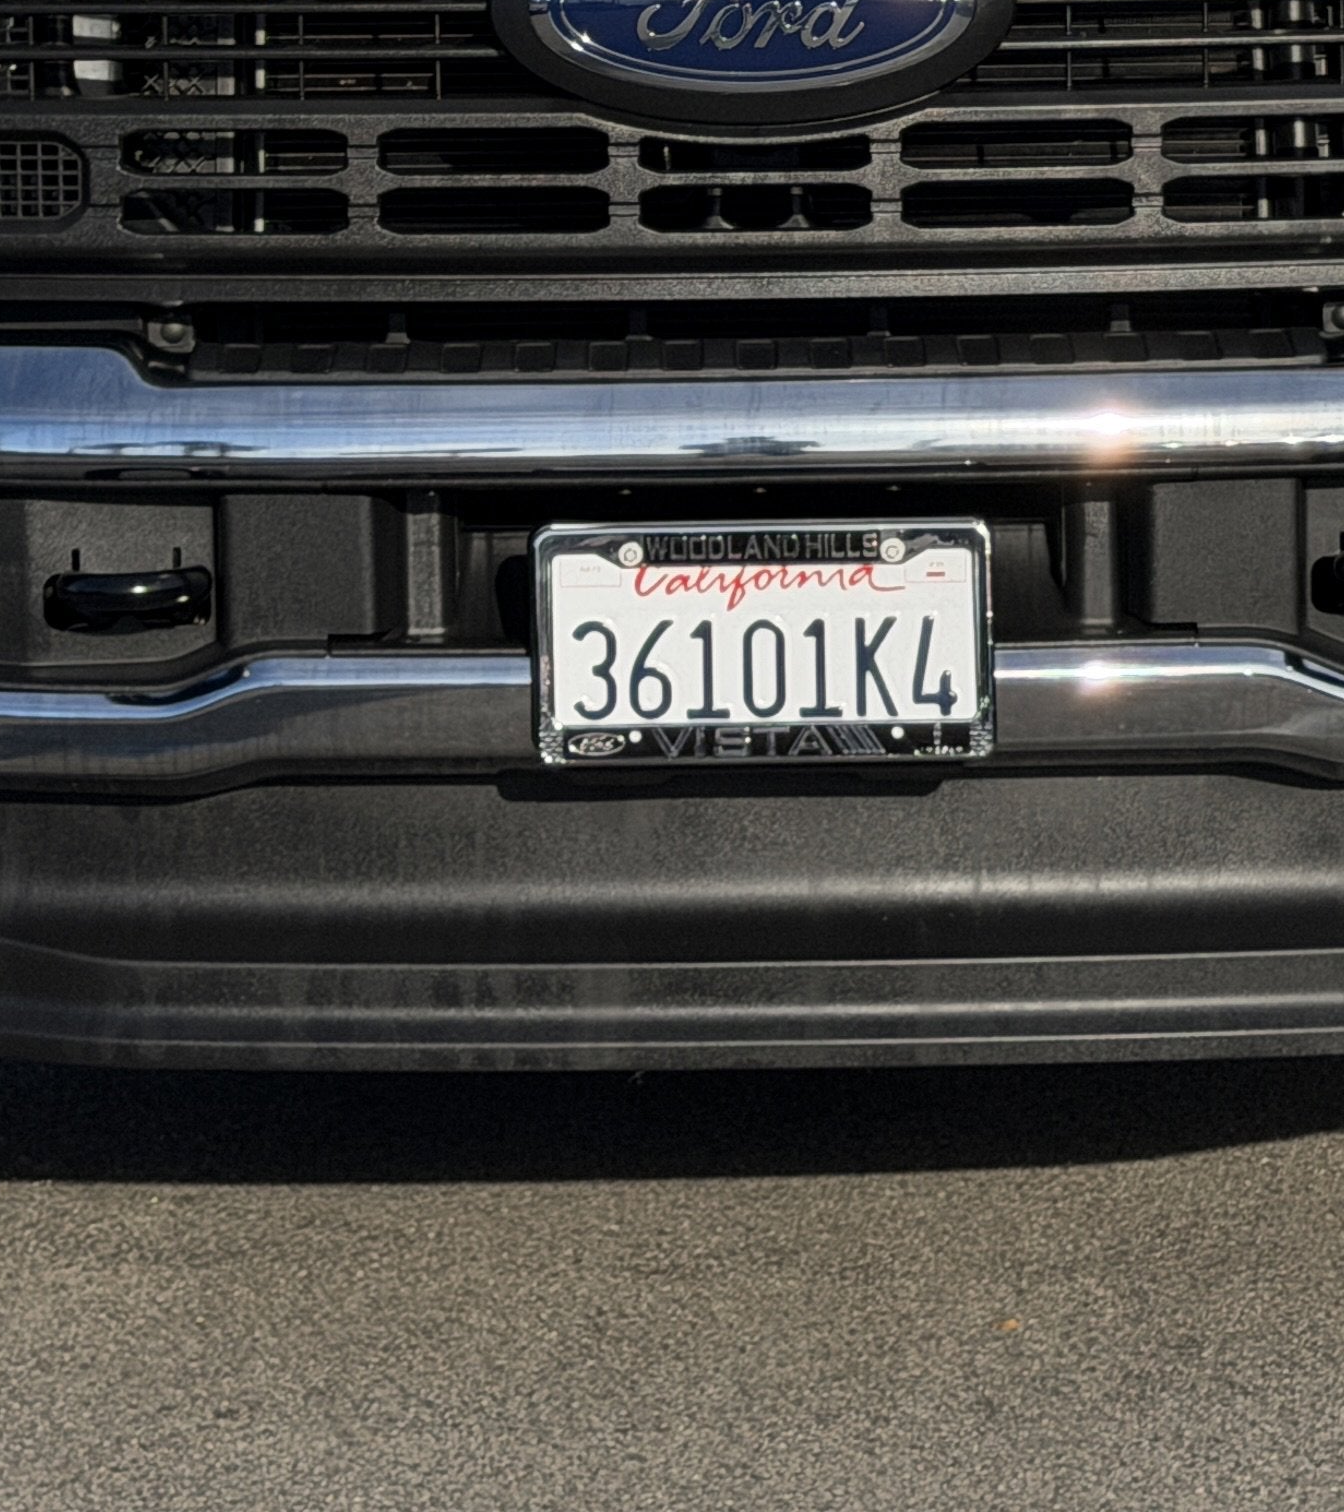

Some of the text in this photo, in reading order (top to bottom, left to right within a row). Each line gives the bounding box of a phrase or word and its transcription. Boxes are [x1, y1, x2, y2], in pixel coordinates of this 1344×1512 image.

[646, 532, 879, 561] WOODLAND HILLS
[634, 563, 906, 612] California
[572, 615, 958, 720] 36101K4
